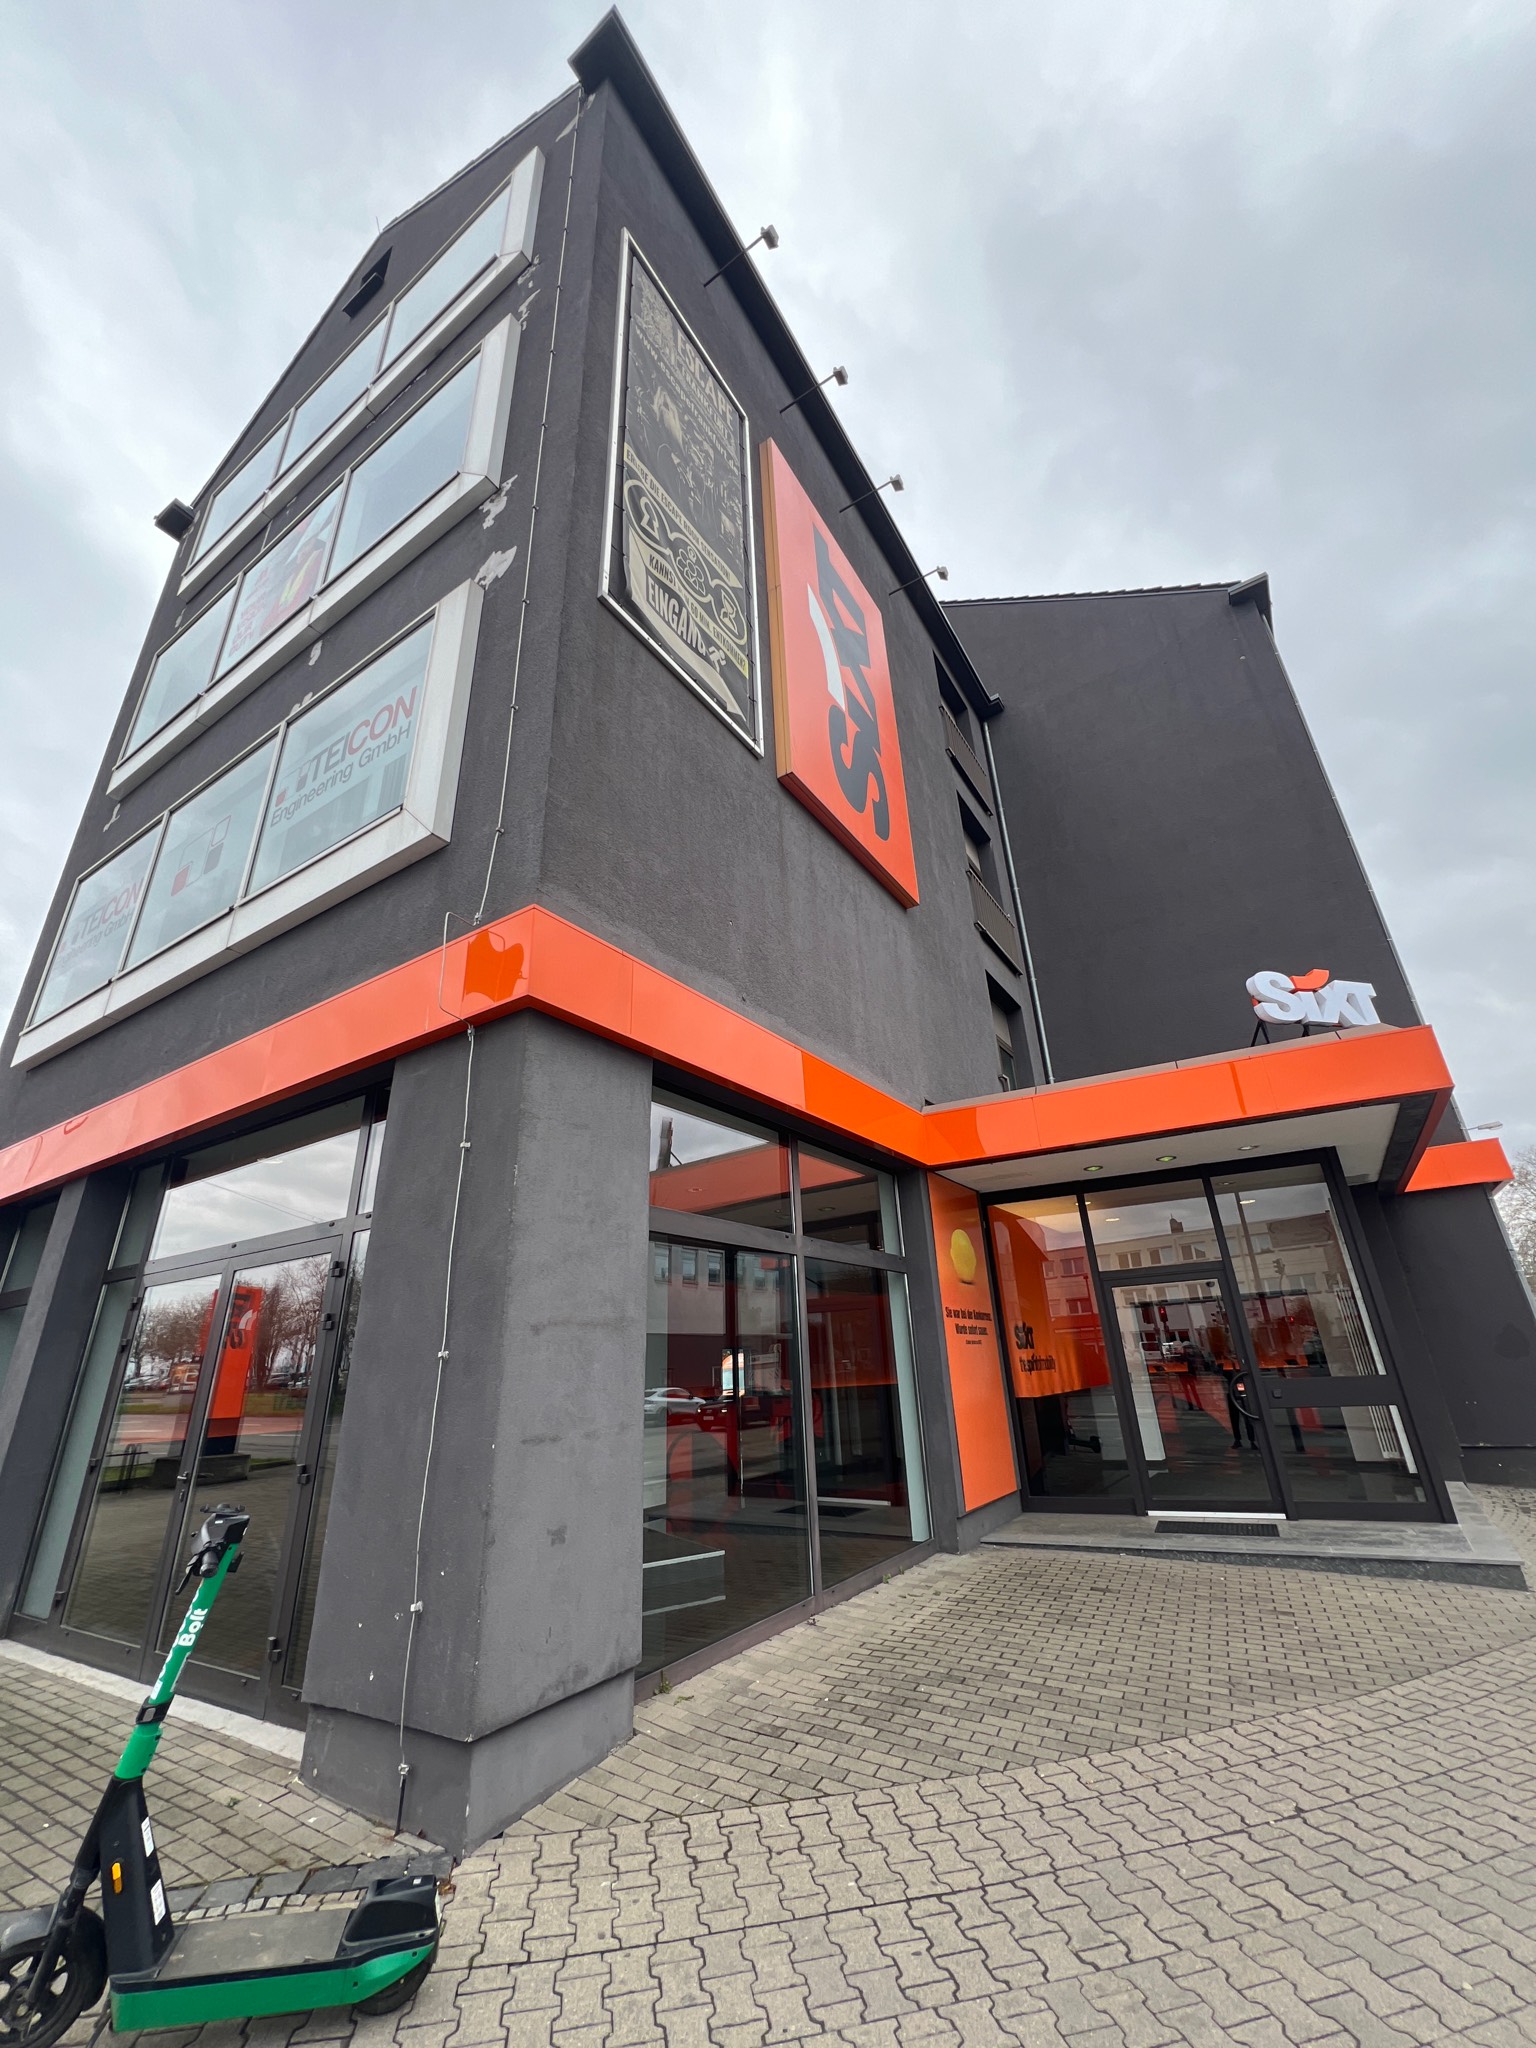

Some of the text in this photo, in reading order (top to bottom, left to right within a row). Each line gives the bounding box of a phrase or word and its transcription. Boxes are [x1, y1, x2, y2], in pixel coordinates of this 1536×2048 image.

[677, 328, 734, 431] ESCAPE
[661, 492, 683, 527] ESCAPE
[270, 720, 412, 828] Engineering GmbH
[310, 684, 418, 783] TEICON
[177, 1608, 209, 1647] Bolt
